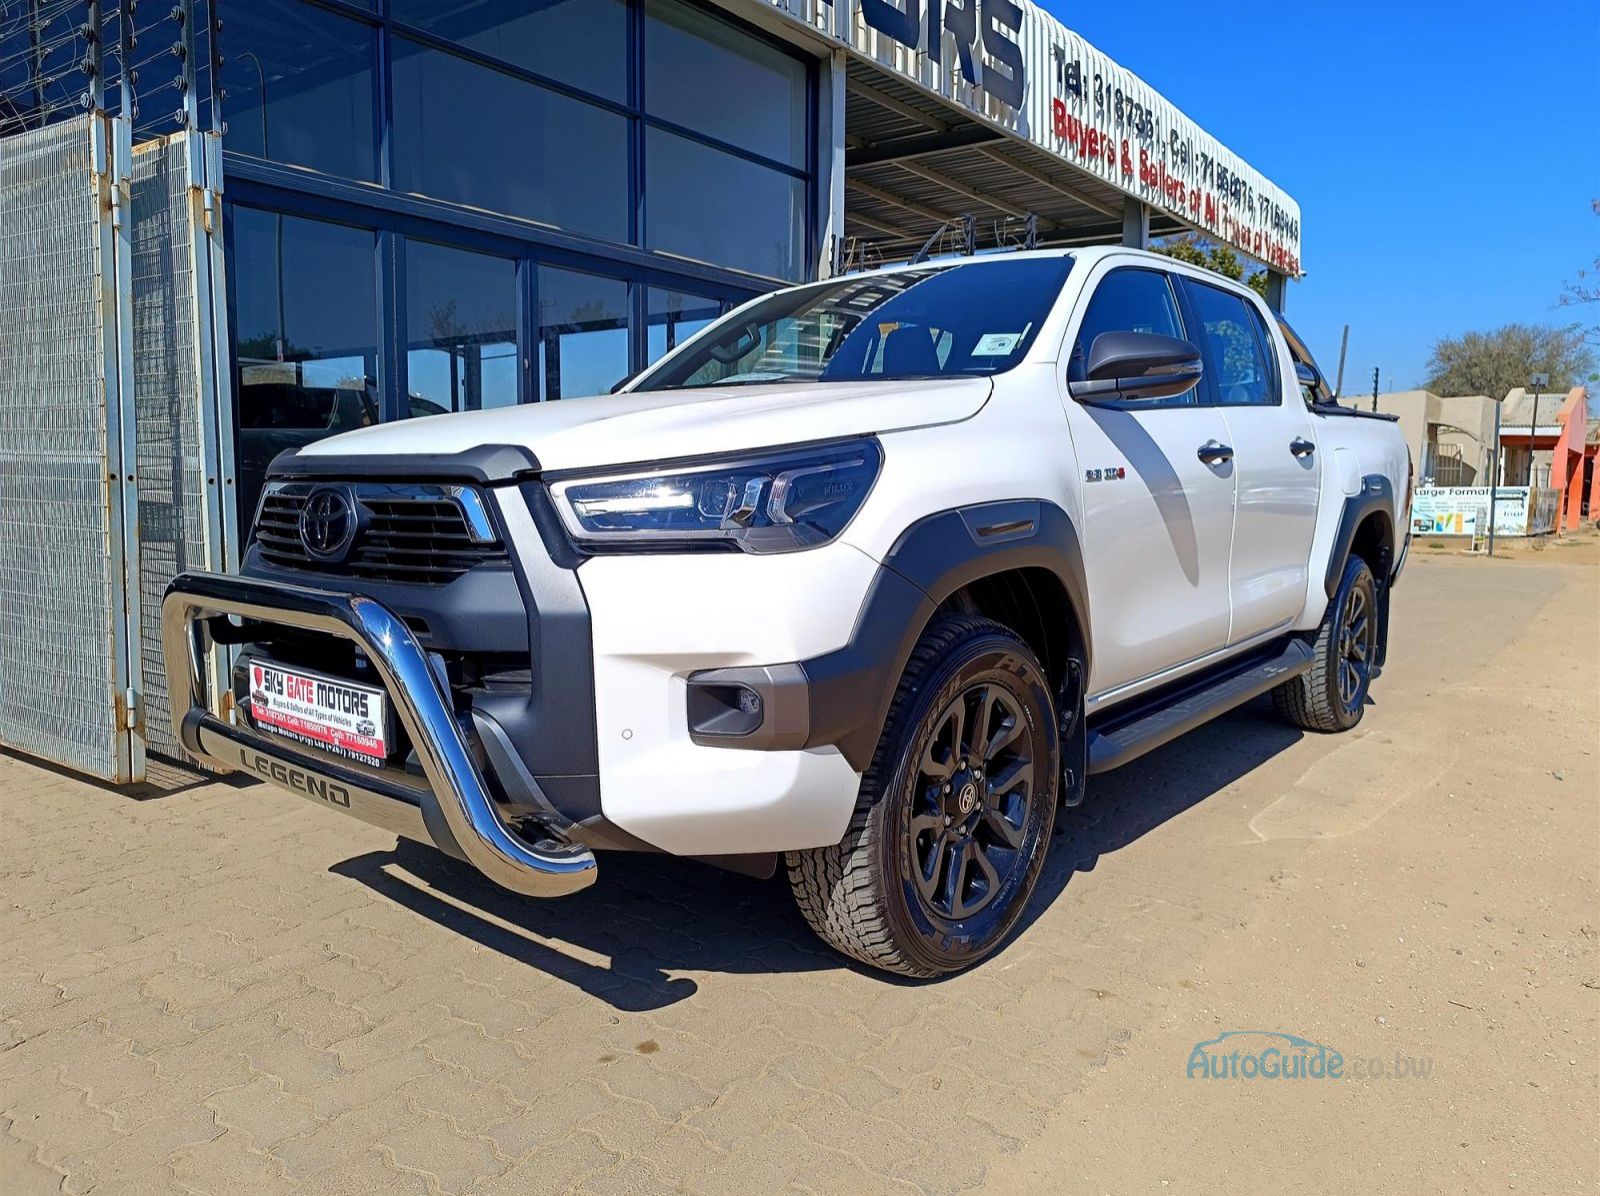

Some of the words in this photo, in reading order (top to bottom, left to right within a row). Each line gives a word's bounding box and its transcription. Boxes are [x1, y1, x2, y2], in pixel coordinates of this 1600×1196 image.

[1053, 43, 1087, 100] Tel:
[1053, 97, 1115, 165] Buyers
[1121, 139, 1133, 176] &
[1139, 149, 1186, 205] Sellers
[1190, 187, 1201, 213] of
[1414, 488, 1445, 497] Large
[1449, 487, 1489, 496] Format
[264, 669, 284, 696] SKY
[287, 676, 314, 704] GATE
[317, 683, 368, 718] MOTORS
[240, 749, 350, 809] LEGEND
